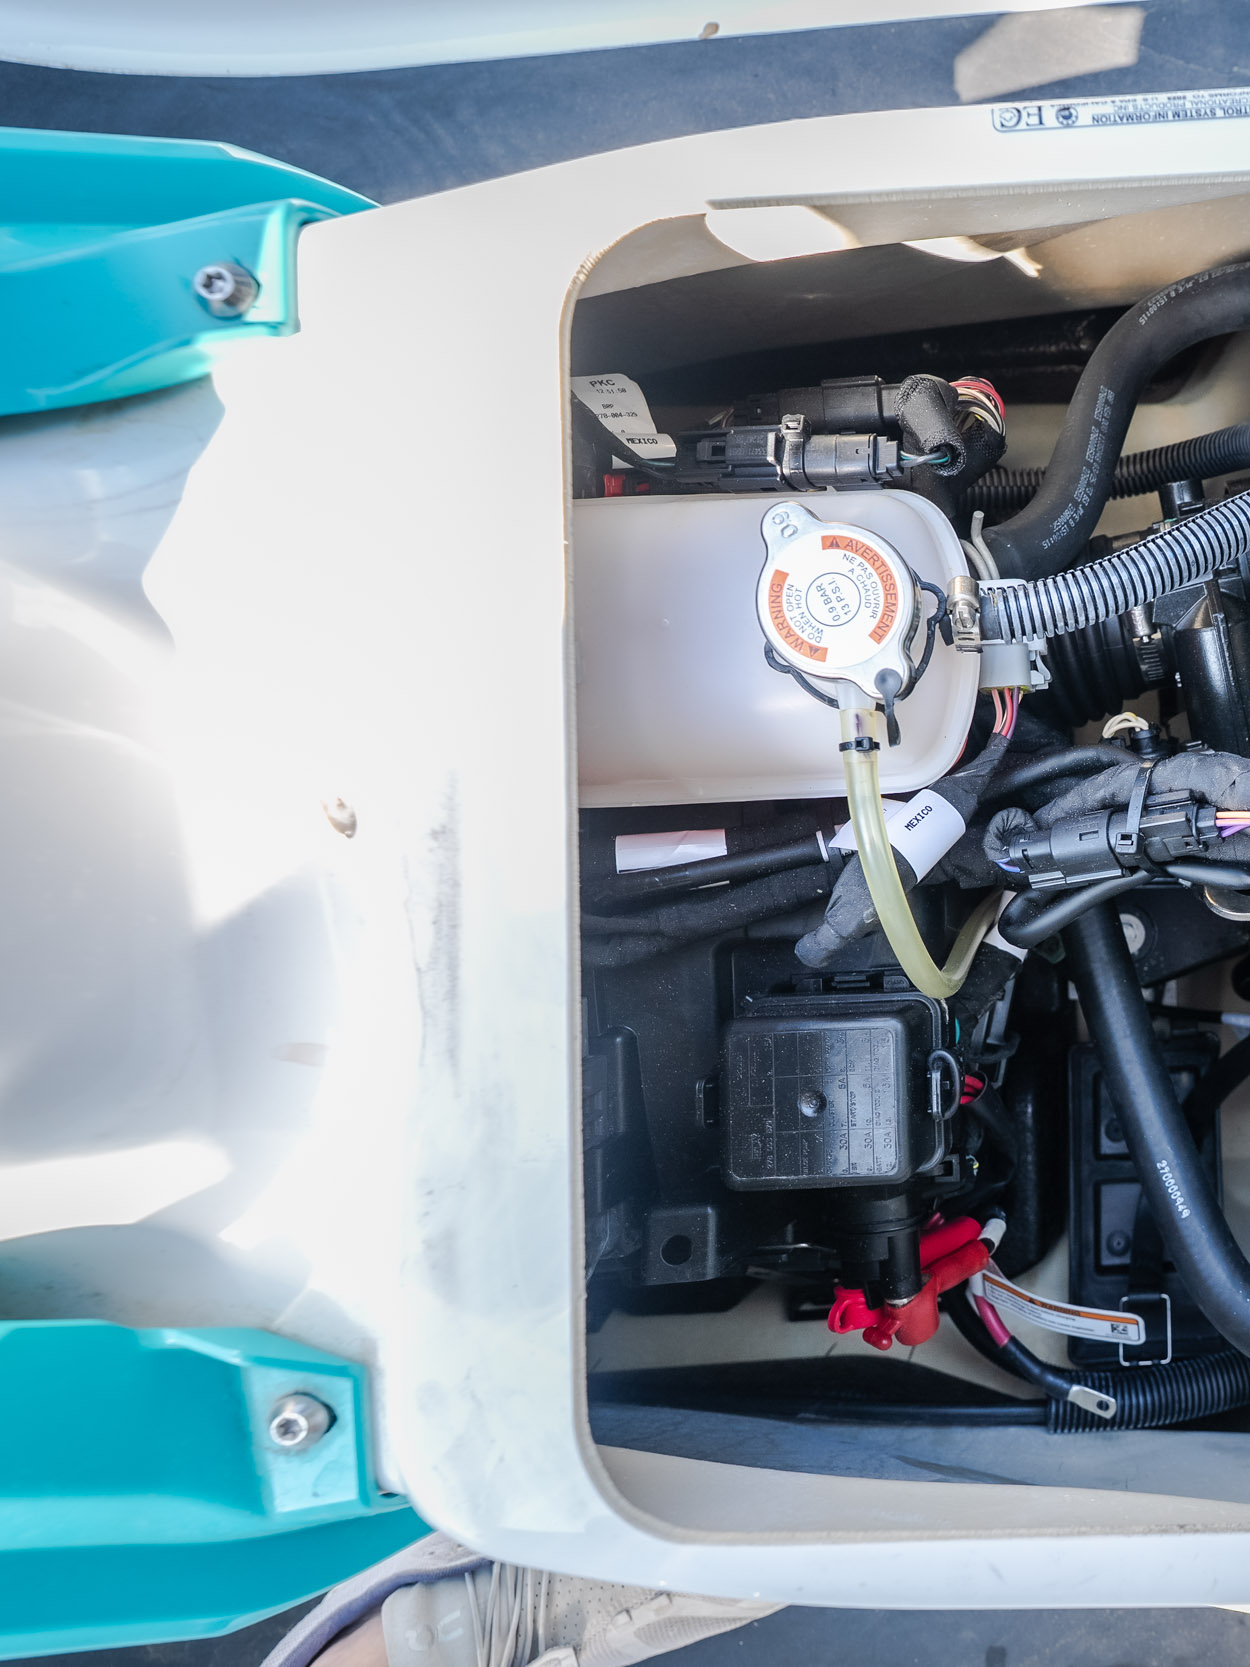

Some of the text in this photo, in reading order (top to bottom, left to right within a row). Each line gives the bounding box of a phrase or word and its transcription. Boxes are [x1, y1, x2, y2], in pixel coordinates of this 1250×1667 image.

[1091, 110, 1168, 124] INFORMATION
[1131, 100, 1185, 111] PRODUCTS
[1172, 107, 1216, 119] SYSTEM
[588, 379, 616, 388] PKC
[626, 437, 658, 445] MEXICO
[815, 583, 840, 622] 0.9 BAR
[842, 553, 881, 620] NE PAS OUVRIR
[843, 539, 898, 642] AVERTISSEMENT
[856, 574, 872, 609] CHAUD
[769, 582, 806, 651] WARNING
[786, 583, 823, 644] DO NOT OPEN
[794, 587, 824, 636] WHEN HOT
[841, 603, 852, 616] 13
[904, 805, 933, 831] MEXICO
[1156, 1159, 1191, 1219] 270000949
